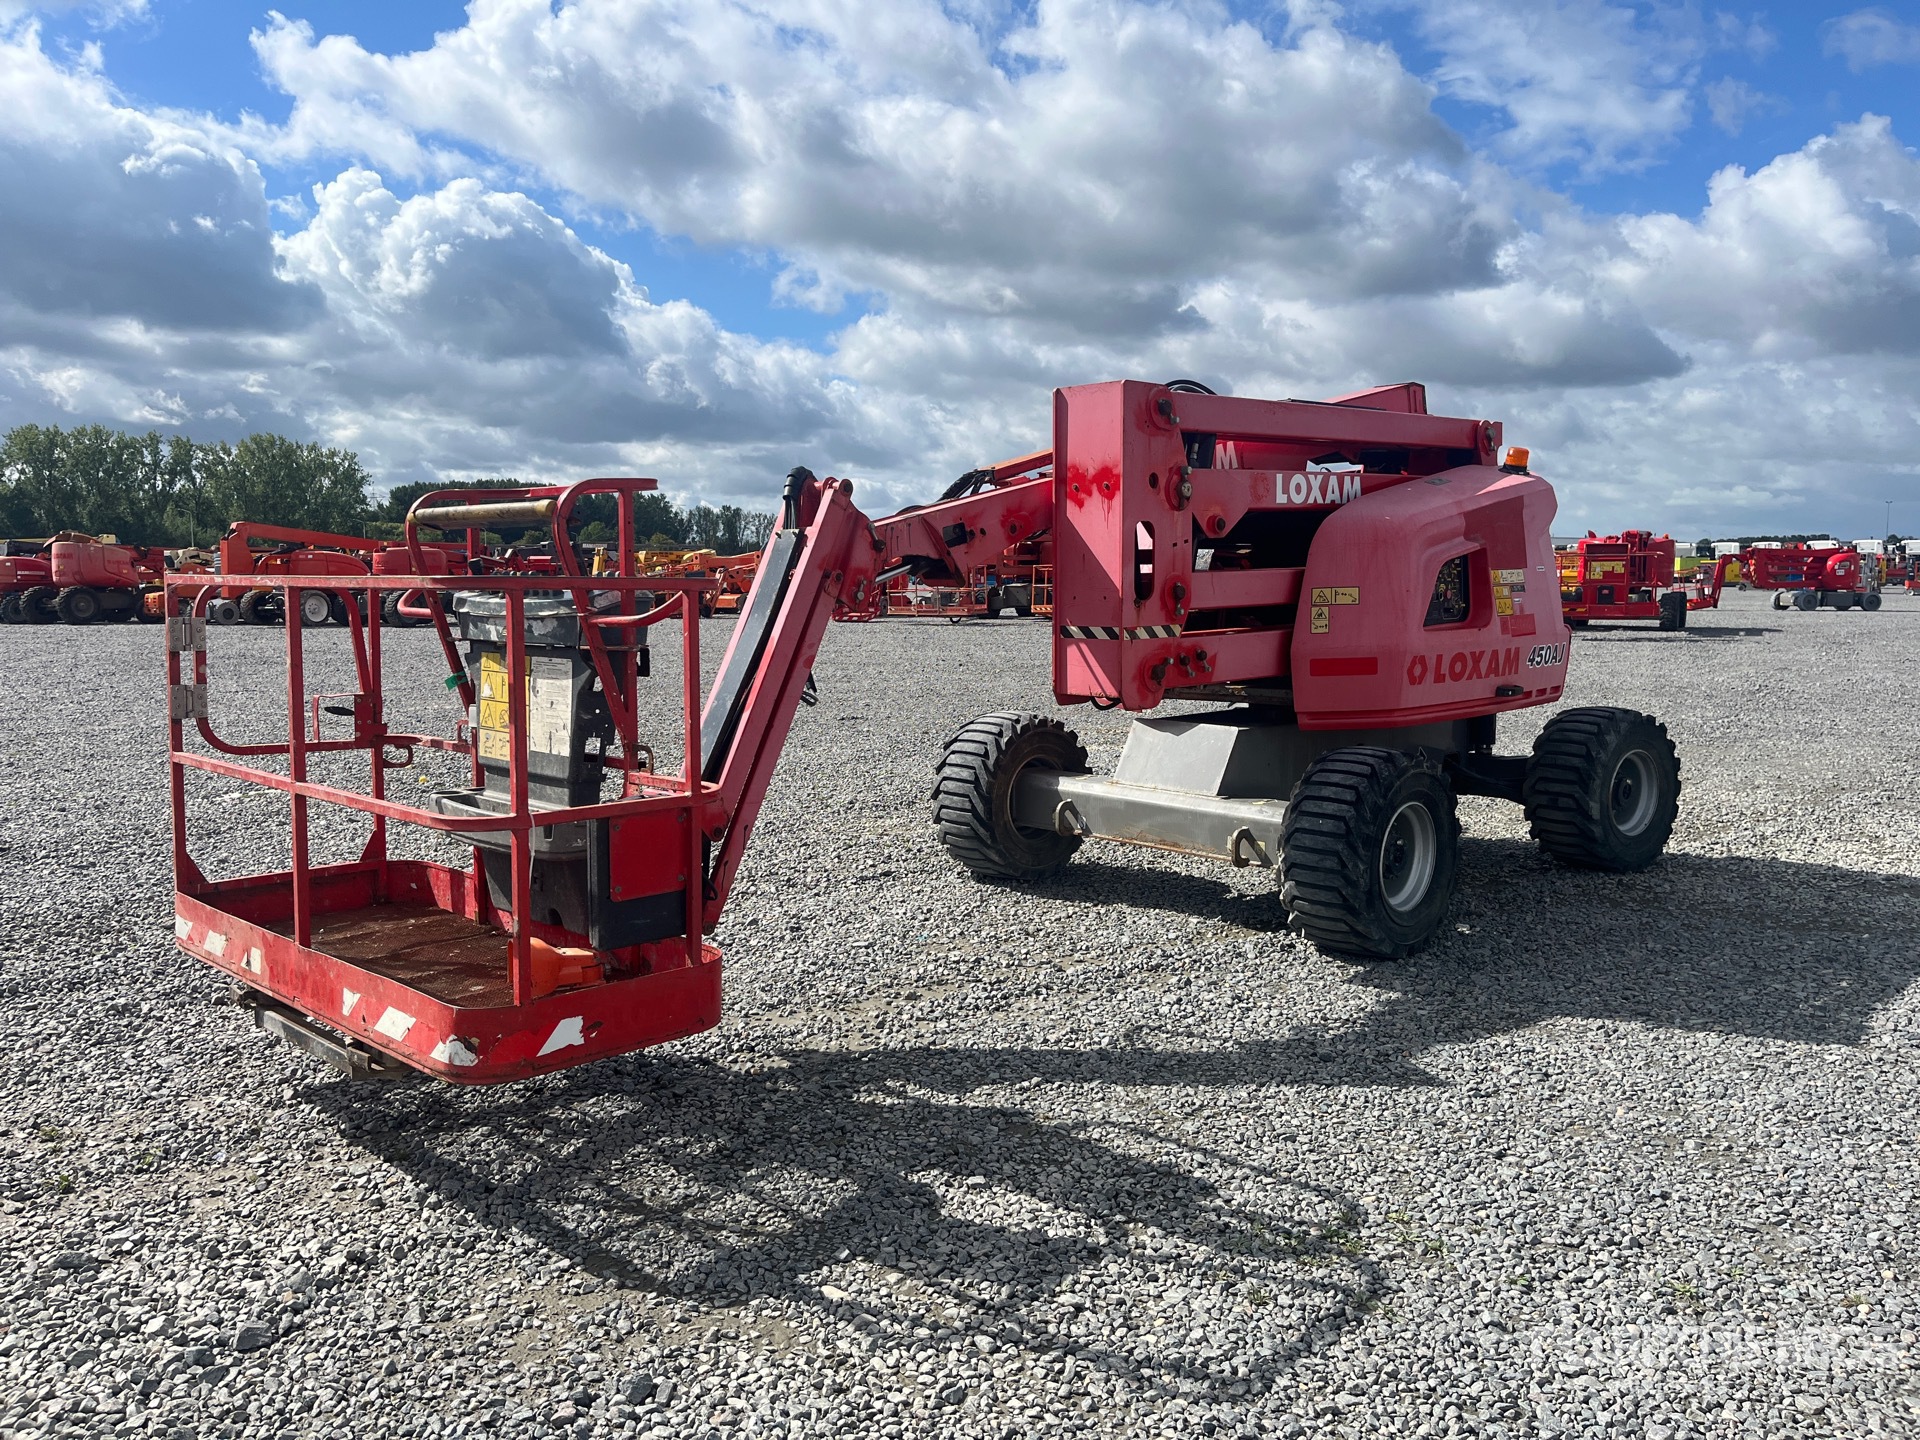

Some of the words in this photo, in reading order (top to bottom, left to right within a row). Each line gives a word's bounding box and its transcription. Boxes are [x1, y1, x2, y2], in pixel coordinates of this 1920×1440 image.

[1275, 473, 1362, 504] LOXAM
[1433, 647, 1521, 684] LOXAM
[1526, 642, 1567, 668] 450AJ
